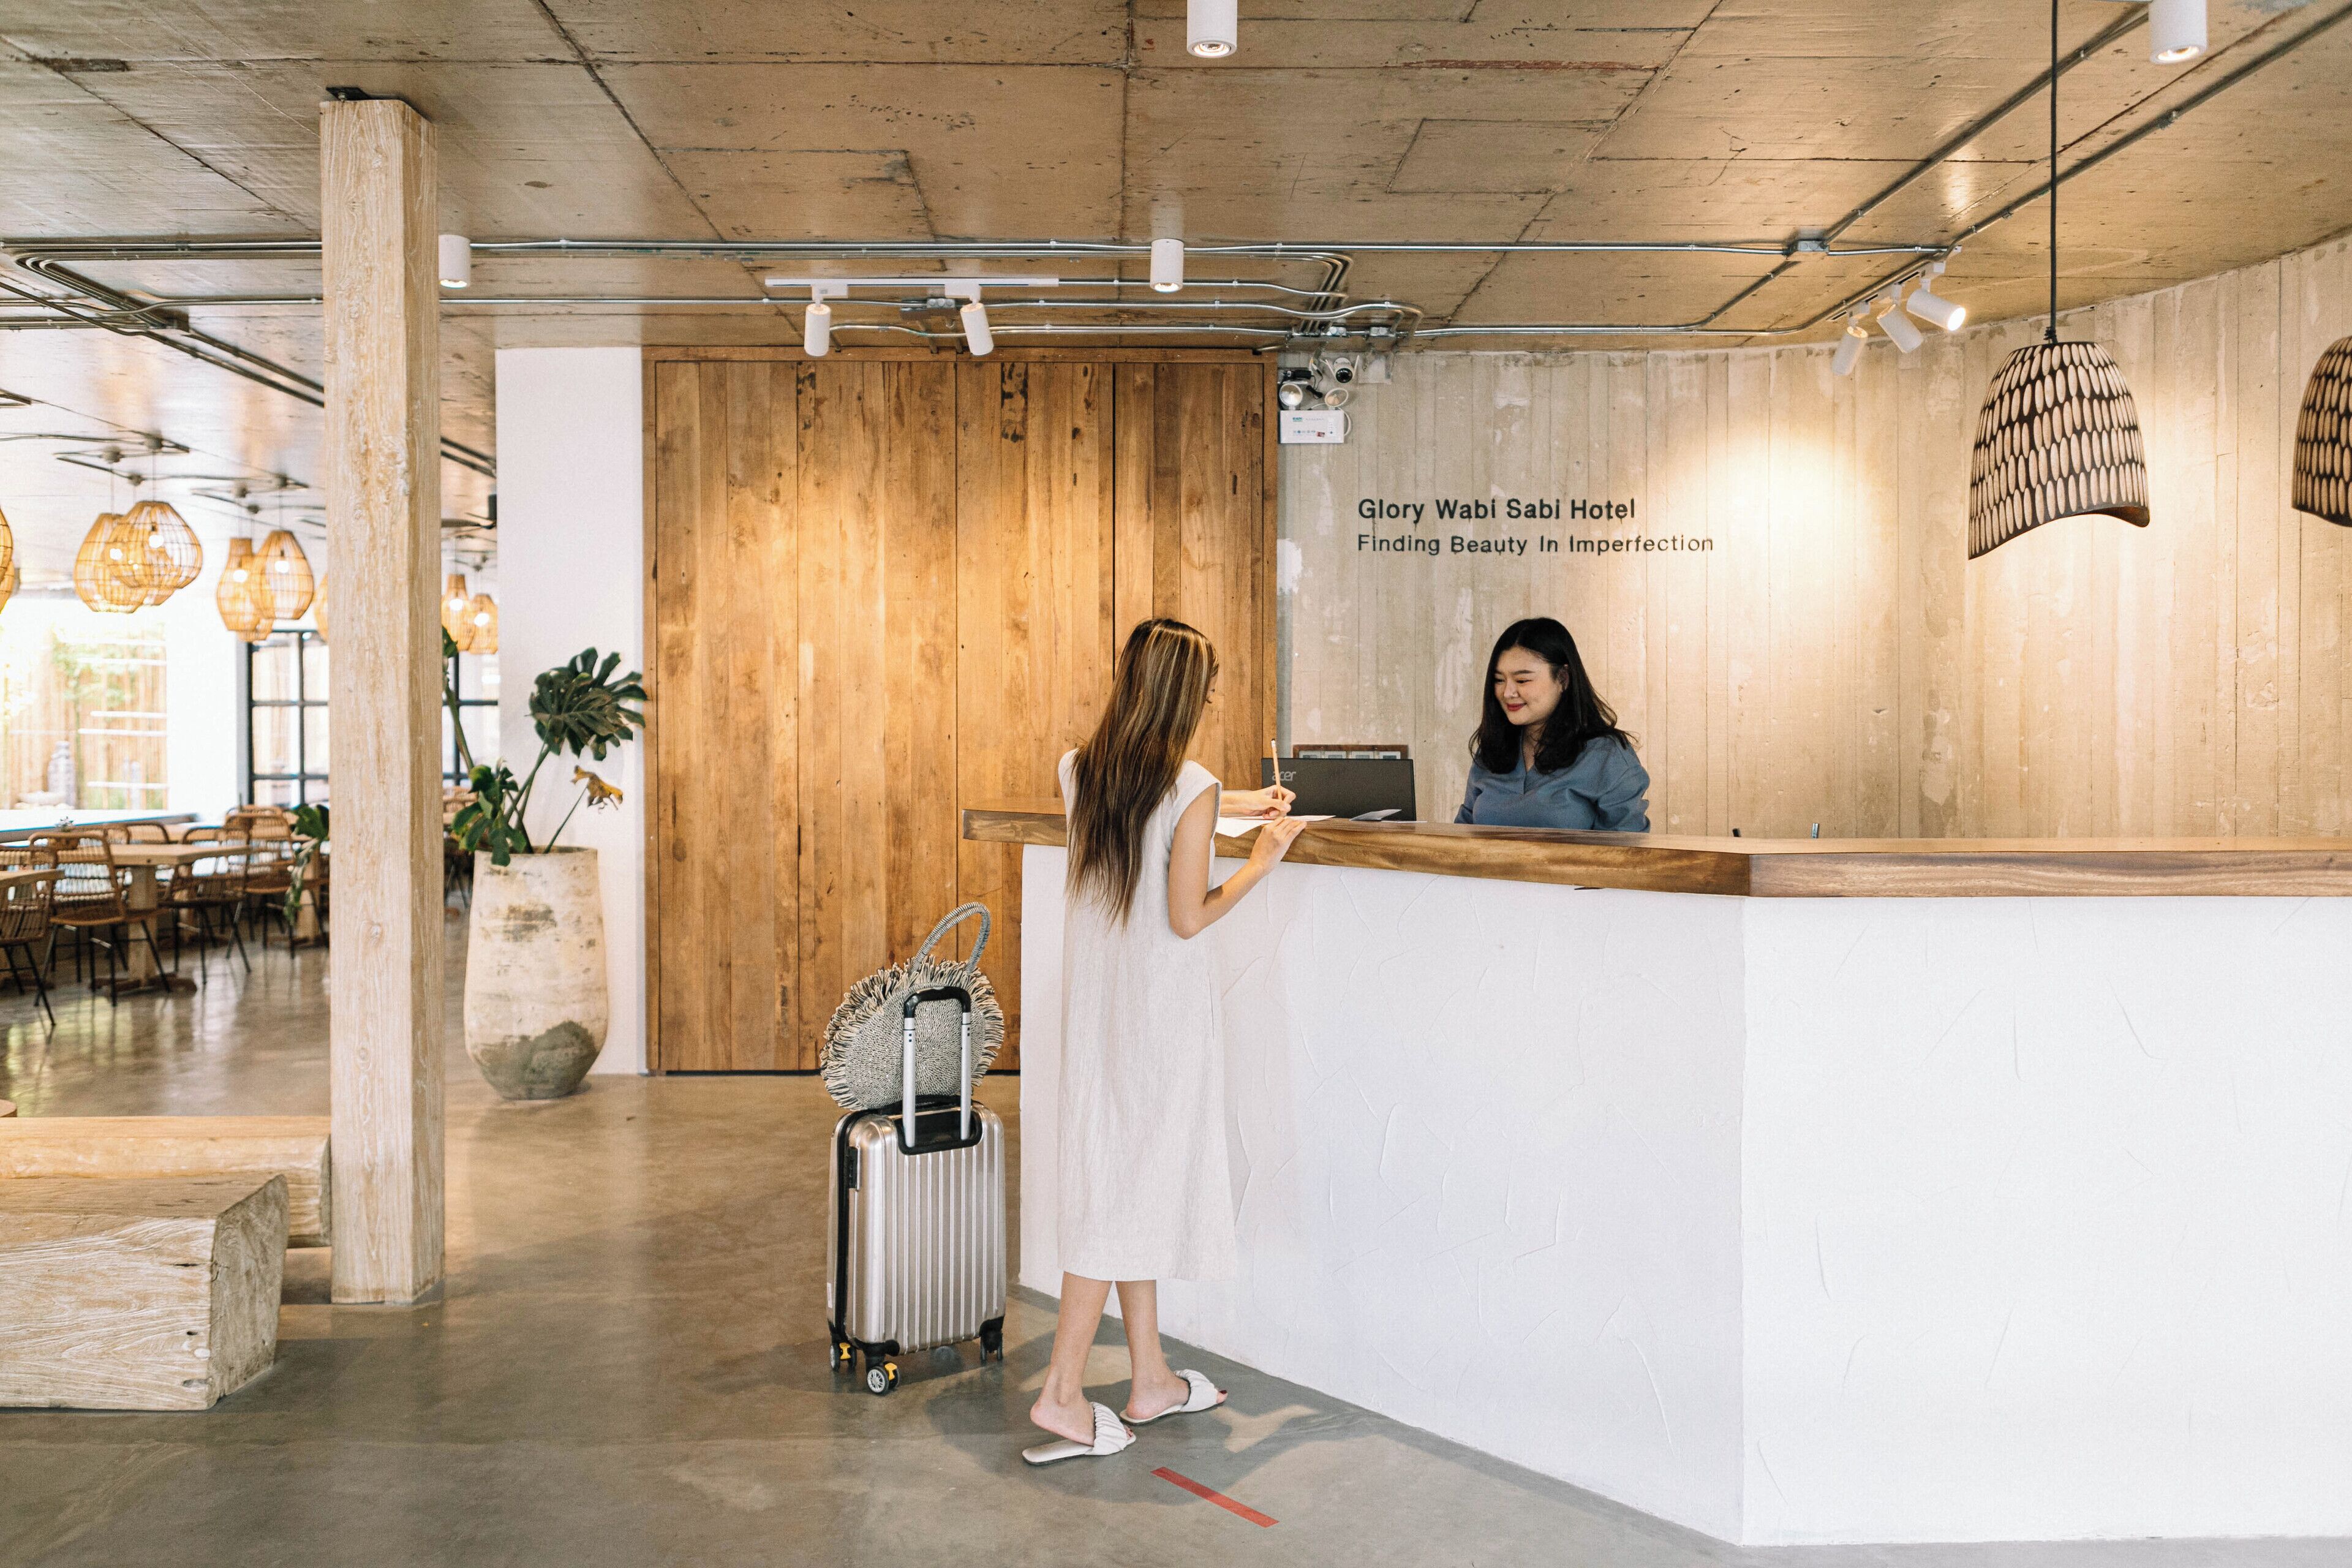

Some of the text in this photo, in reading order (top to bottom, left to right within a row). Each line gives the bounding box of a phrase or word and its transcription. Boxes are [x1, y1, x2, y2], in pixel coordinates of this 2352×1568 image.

[1358, 497, 1635, 524] Glory Wabi Sabi Hotel
[1358, 534, 1713, 556] Finding Beauty In Imperfection
